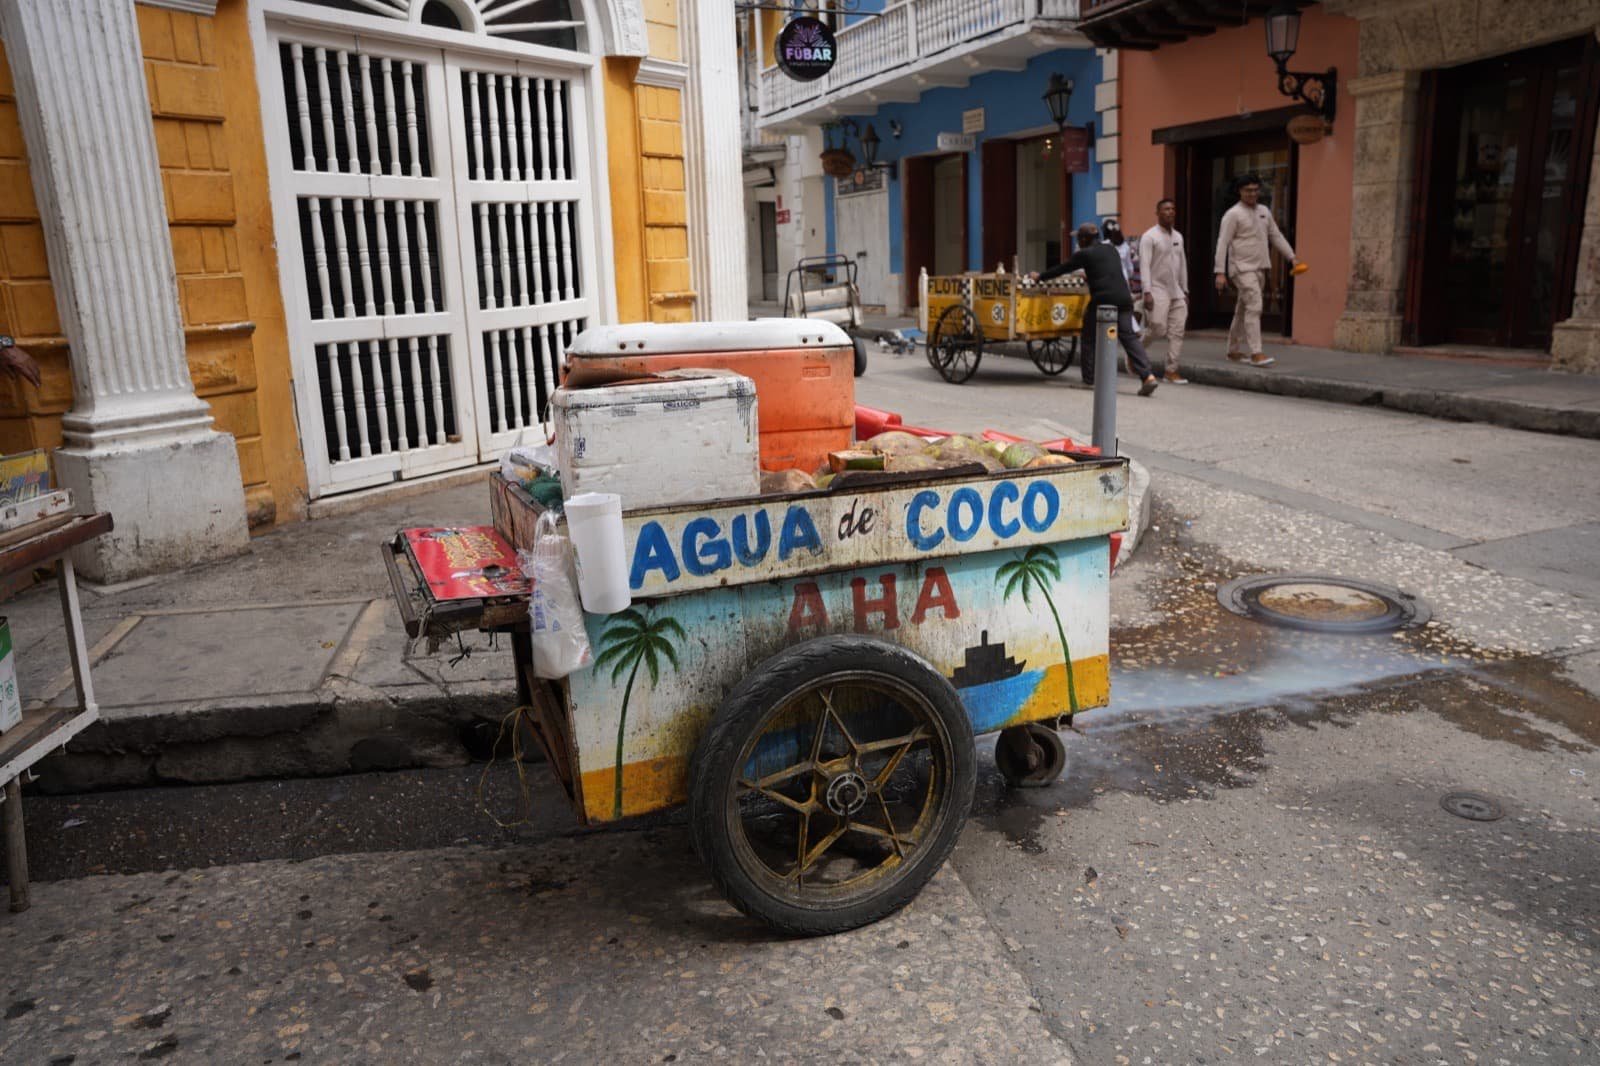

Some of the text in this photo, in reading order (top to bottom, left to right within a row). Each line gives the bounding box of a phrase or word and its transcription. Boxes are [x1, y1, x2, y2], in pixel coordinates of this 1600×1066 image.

[928, 278, 1011, 297] FLOTA NENE
[992, 305, 1005, 321] 30
[1052, 303, 1067, 321] 30
[629, 480, 1060, 589] AGUA de COCO
[787, 567, 961, 634] AHA
